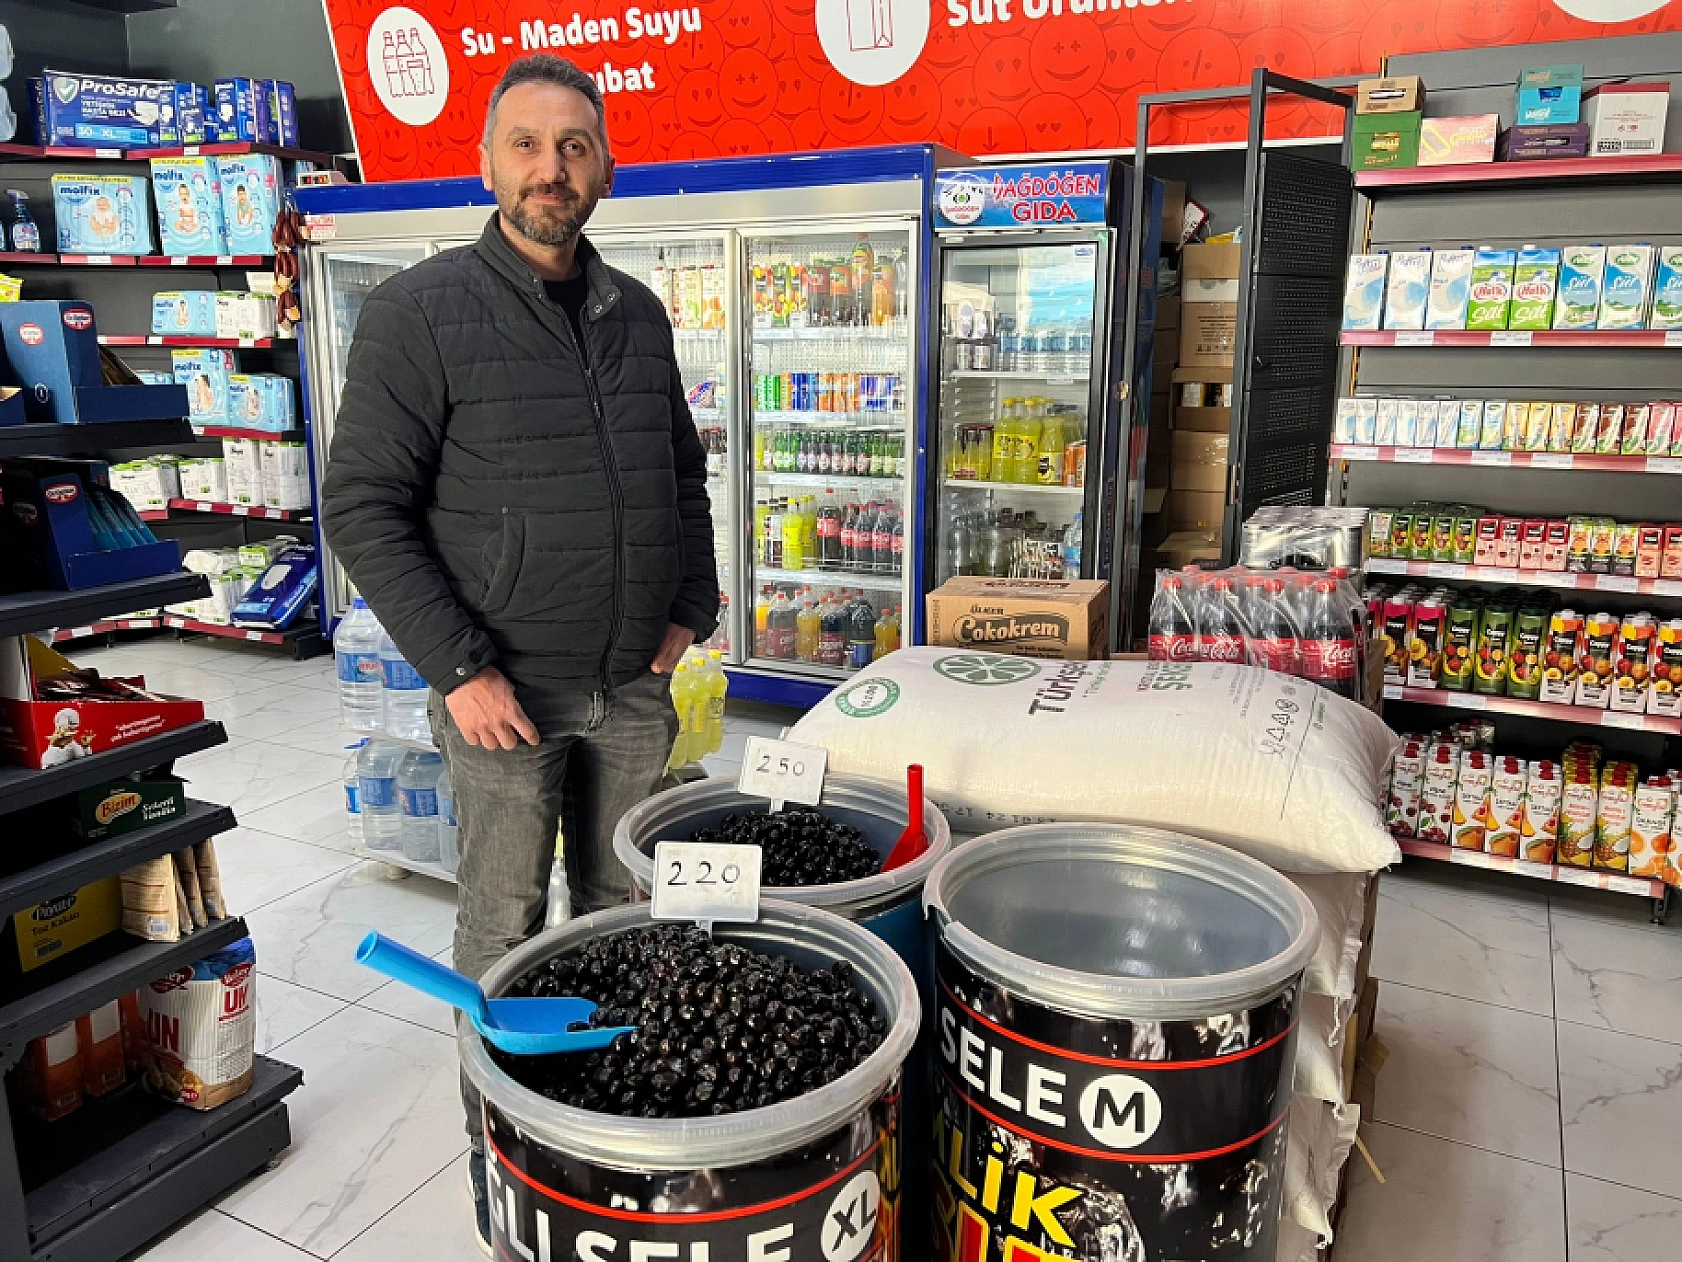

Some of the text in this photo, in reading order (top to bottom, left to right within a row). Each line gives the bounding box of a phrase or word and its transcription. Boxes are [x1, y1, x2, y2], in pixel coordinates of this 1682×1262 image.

[461, 27, 496, 57] Su
[520, 14, 619, 51] Maden
[625, 6, 702, 46] Suyu
[80, 79, 160, 99] ProSafe
[589, 60, 656, 95] ubat
[60, 185, 100, 196] molfix
[1012, 200, 1078, 223] GIDA
[755, 755, 806, 778] 250
[666, 860, 742, 887] 220
[224, 984, 249, 1014] UN
[940, 1006, 1147, 1134] SELE M
[831, 1190, 877, 1253] XL
